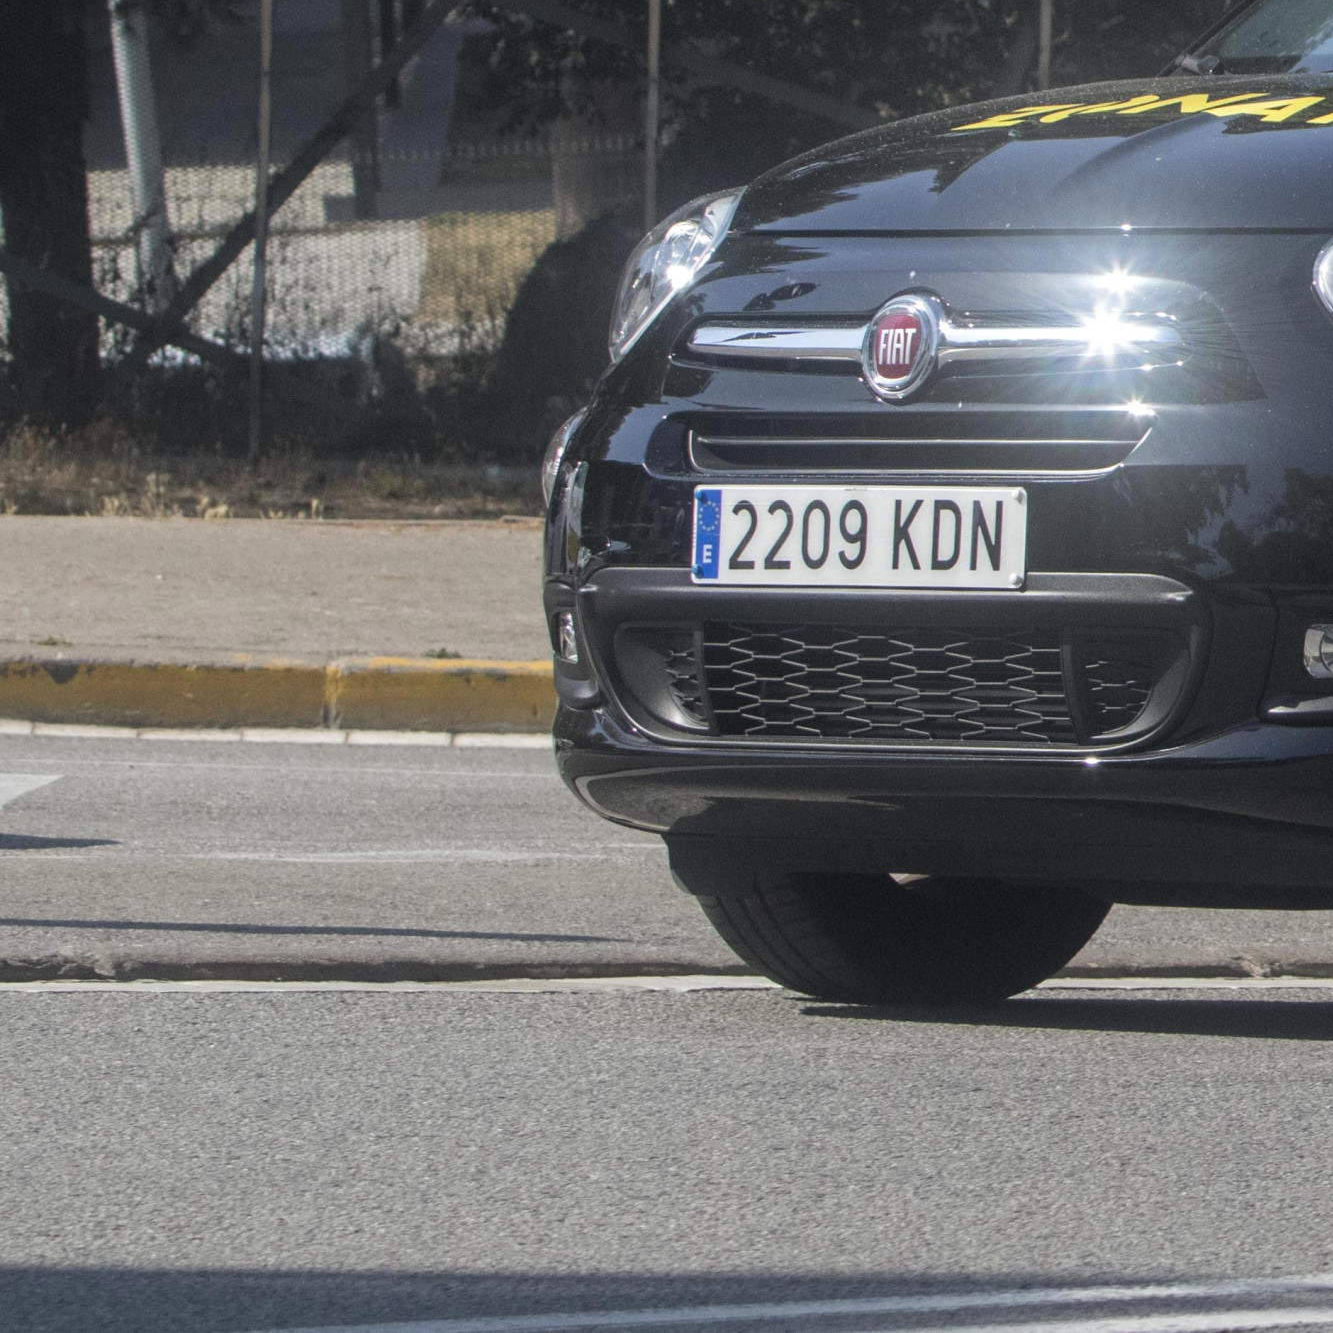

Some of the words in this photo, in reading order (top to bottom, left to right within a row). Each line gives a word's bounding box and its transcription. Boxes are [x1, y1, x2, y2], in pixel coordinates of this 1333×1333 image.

[879, 328, 917, 365] FIAT
[702, 543, 713, 564] E
[728, 499, 868, 570] 2209
[891, 499, 1004, 571] KDN
